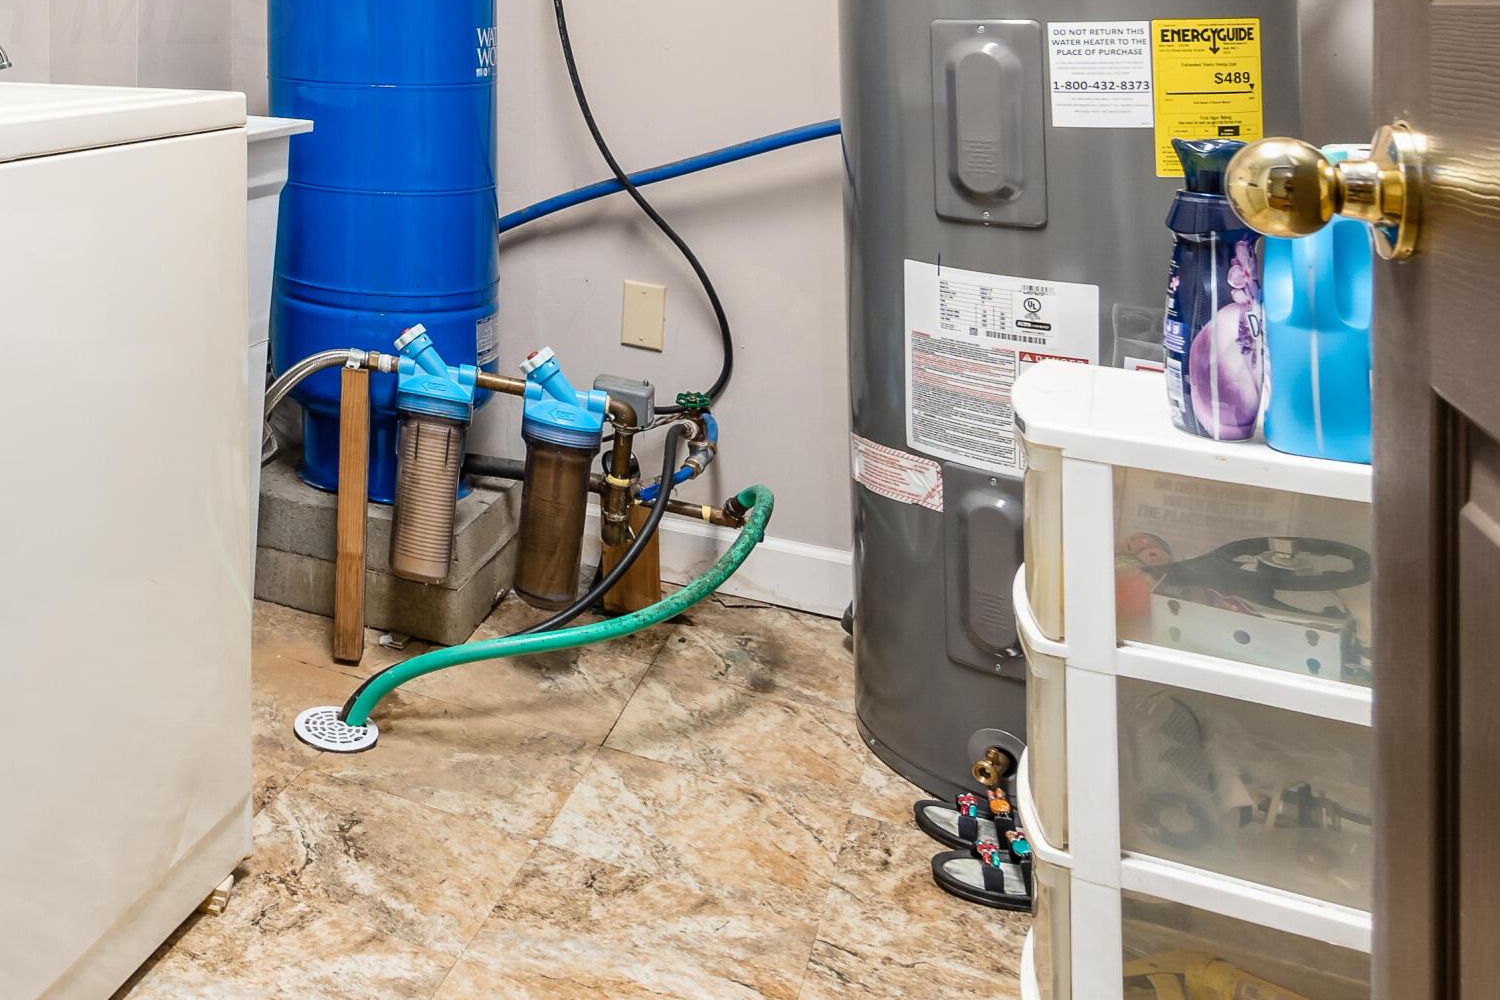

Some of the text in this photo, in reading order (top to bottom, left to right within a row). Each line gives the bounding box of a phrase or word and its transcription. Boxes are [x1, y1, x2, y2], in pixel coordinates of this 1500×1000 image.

[1090, 28, 1124, 36] RETURN
[1160, 27, 1254, 43] ENERGYGUIDE
[1099, 48, 1142, 56] PURCHASE
[1054, 81, 1150, 90] 1-800-432-8373
[1028, 300, 1037, 311] UL
